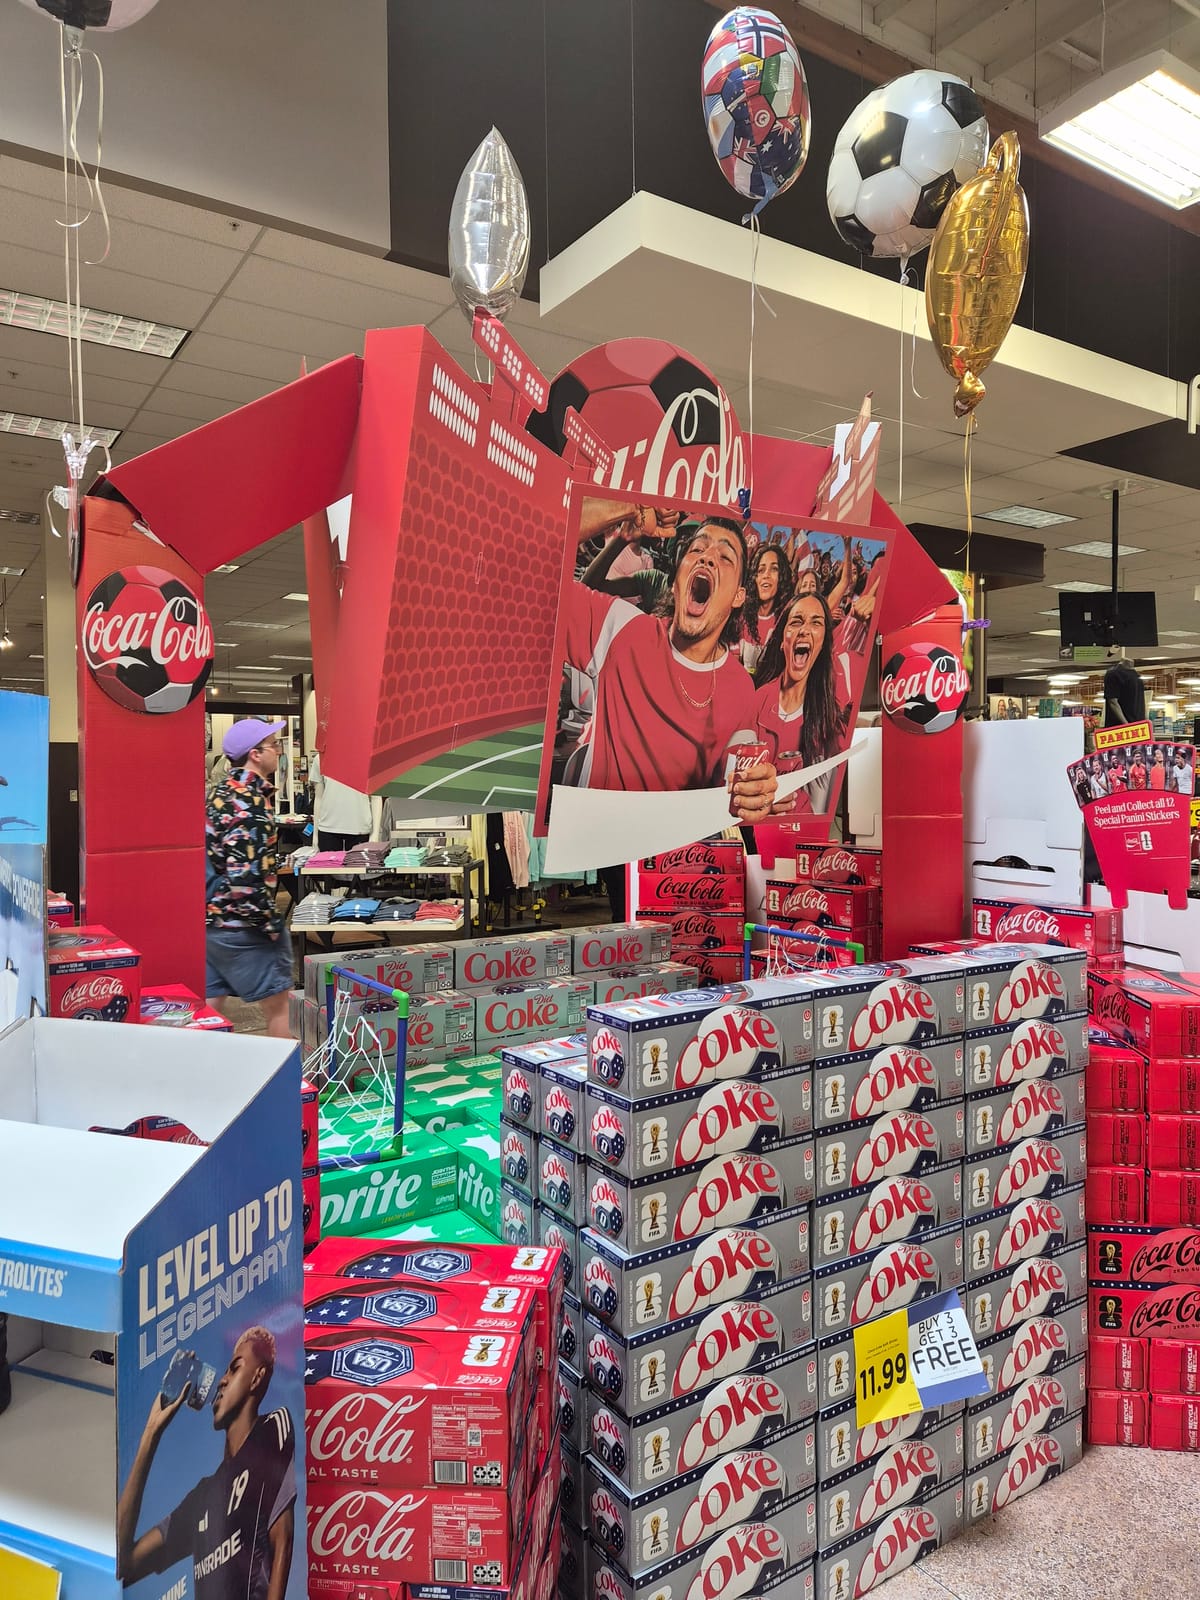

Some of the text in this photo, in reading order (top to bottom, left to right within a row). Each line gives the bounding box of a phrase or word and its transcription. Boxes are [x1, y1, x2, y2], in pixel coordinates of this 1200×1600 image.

[82, 596, 211, 670] Coca-Cola
[882, 655, 968, 714] Coca-Cola
[1099, 727, 1147, 745] PANINI
[1094, 797, 1175, 815] Peel and Collect all 12
[1094, 814, 1120, 828] Special
[1121, 813, 1145, 824] Panini
[1145, 810, 1180, 821] Stickers
[661, 845, 716, 873] Coca-Cola
[812, 850, 858, 879] Coca-Cola
[656, 877, 729, 900] Coca-Cola
[782, 888, 828, 917] Coca-Cola
[623, 934, 640, 944] Diet
[672, 915, 717, 937] a-Cola
[995, 910, 1060, 943] Coca-Cola
[385, 961, 407, 971] Diet
[464, 951, 537, 983] Coke
[512, 947, 532, 956] Diet
[582, 938, 644, 969] Coke
[61, 976, 124, 1013] Coca-Cola
[534, 994, 553, 1004] Diet
[648, 979, 664, 987] Diet
[993, 966, 1064, 1024] Coke
[408, 1012, 428, 1023] Diet
[484, 1001, 559, 1034] Coke
[733, 1008, 762, 1018] Diet
[848, 985, 935, 1051] Coke
[348, 1020, 433, 1055] Coke
[674, 1014, 778, 1090] Coke
[996, 1027, 1064, 1086] Coke
[732, 1083, 762, 1092] Diet
[850, 1051, 936, 1120] Coke
[674, 1089, 778, 1167] Coke
[997, 1087, 1062, 1145] Coke
[650, 1154, 662, 1162] FIFA
[733, 1155, 762, 1163] Diet
[851, 1116, 936, 1187] Coke
[457, 1163, 494, 1216] rite
[994, 1146, 1061, 1208] Coke
[320, 1169, 422, 1229] prite
[674, 1161, 779, 1241] Coke
[648, 1229, 660, 1237] FIFA
[728, 1231, 757, 1240] Diet
[849, 1183, 934, 1256] Coke
[139, 1179, 292, 1327] LEVEL UP TO
[993, 1206, 1061, 1270] Coke
[0, 1258, 68, 1297] TROLYTES
[420, 1257, 451, 1272] USA
[669, 1238, 774, 1321] Coke
[139, 1232, 292, 1370] LEGENDARY
[850, 1250, 936, 1325] Coke
[995, 1265, 1063, 1332] Coke
[382, 1299, 418, 1315] USA
[731, 1303, 760, 1312] Diet
[918, 1312, 953, 1334] BUY 3
[919, 1326, 957, 1346] GET 3
[351, 1353, 392, 1374] USA
[673, 1309, 777, 1398] Coke
[912, 1337, 976, 1374] FREE
[997, 1323, 1063, 1392] Coke
[648, 1388, 659, 1396] FIFA
[736, 1376, 765, 1385] Diet
[860, 1352, 907, 1400] 11.99
[677, 1383, 782, 1474] Coke
[997, 1382, 1063, 1453] Coke
[652, 1466, 664, 1474] FIFA
[734, 1452, 764, 1462] Diet
[332, 1469, 378, 1479] TASTE
[855, 1447, 936, 1530] Coke
[992, 1440, 1059, 1512] Coke
[227, 1469, 249, 1516] 19
[675, 1457, 780, 1554] Coke
[736, 1523, 766, 1535] Diet
[650, 1546, 662, 1555] FIFA
[684, 1529, 781, 1600] Coke
[855, 1512, 936, 1599] Coke
[333, 1564, 379, 1575] TASTE
[158, 1575, 187, 1600] MINE
